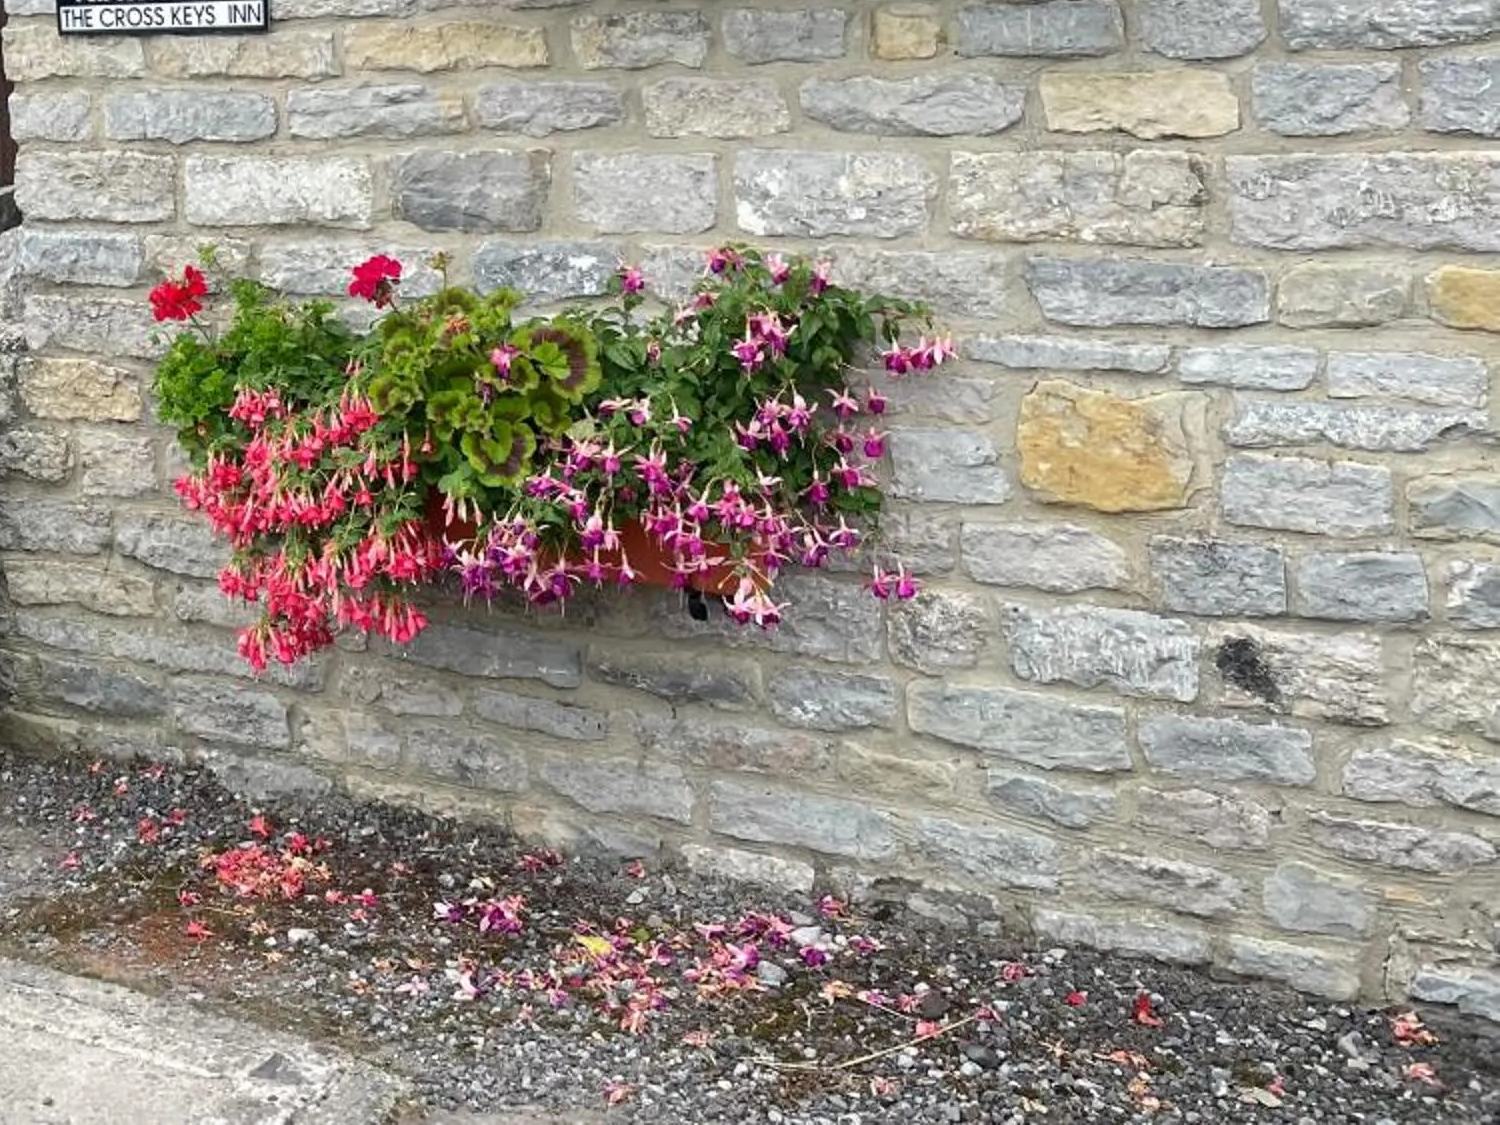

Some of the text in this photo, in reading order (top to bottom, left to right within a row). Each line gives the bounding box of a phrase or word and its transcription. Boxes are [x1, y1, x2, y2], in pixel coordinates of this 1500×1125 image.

[63, 3, 261, 27] THE CROSS KEYS INN
